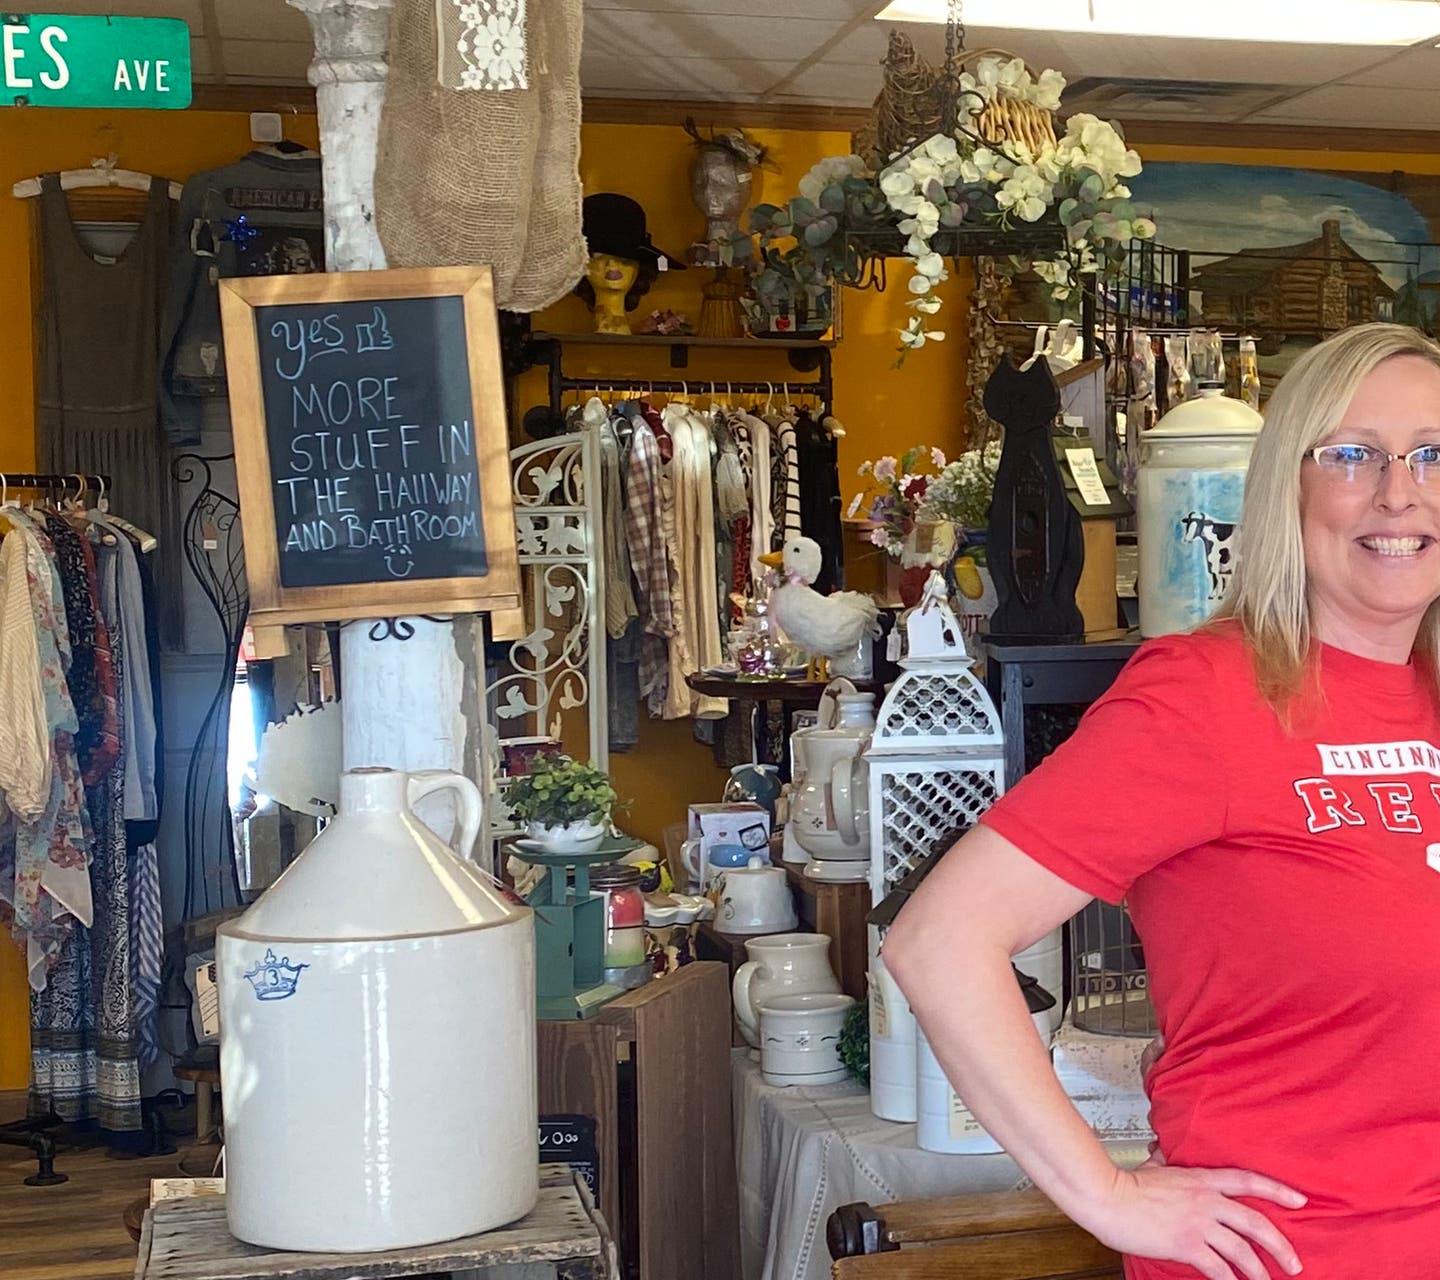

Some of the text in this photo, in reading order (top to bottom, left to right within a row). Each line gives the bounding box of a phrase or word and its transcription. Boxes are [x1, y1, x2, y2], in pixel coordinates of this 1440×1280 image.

[114, 59, 170, 92] AVE
[292, 377, 403, 428] MORE
[290, 420, 471, 472] STUFF IN
[278, 476, 355, 516] THE
[285, 511, 478, 552] AND BATHROOM
[268, 968, 279, 986] 3
